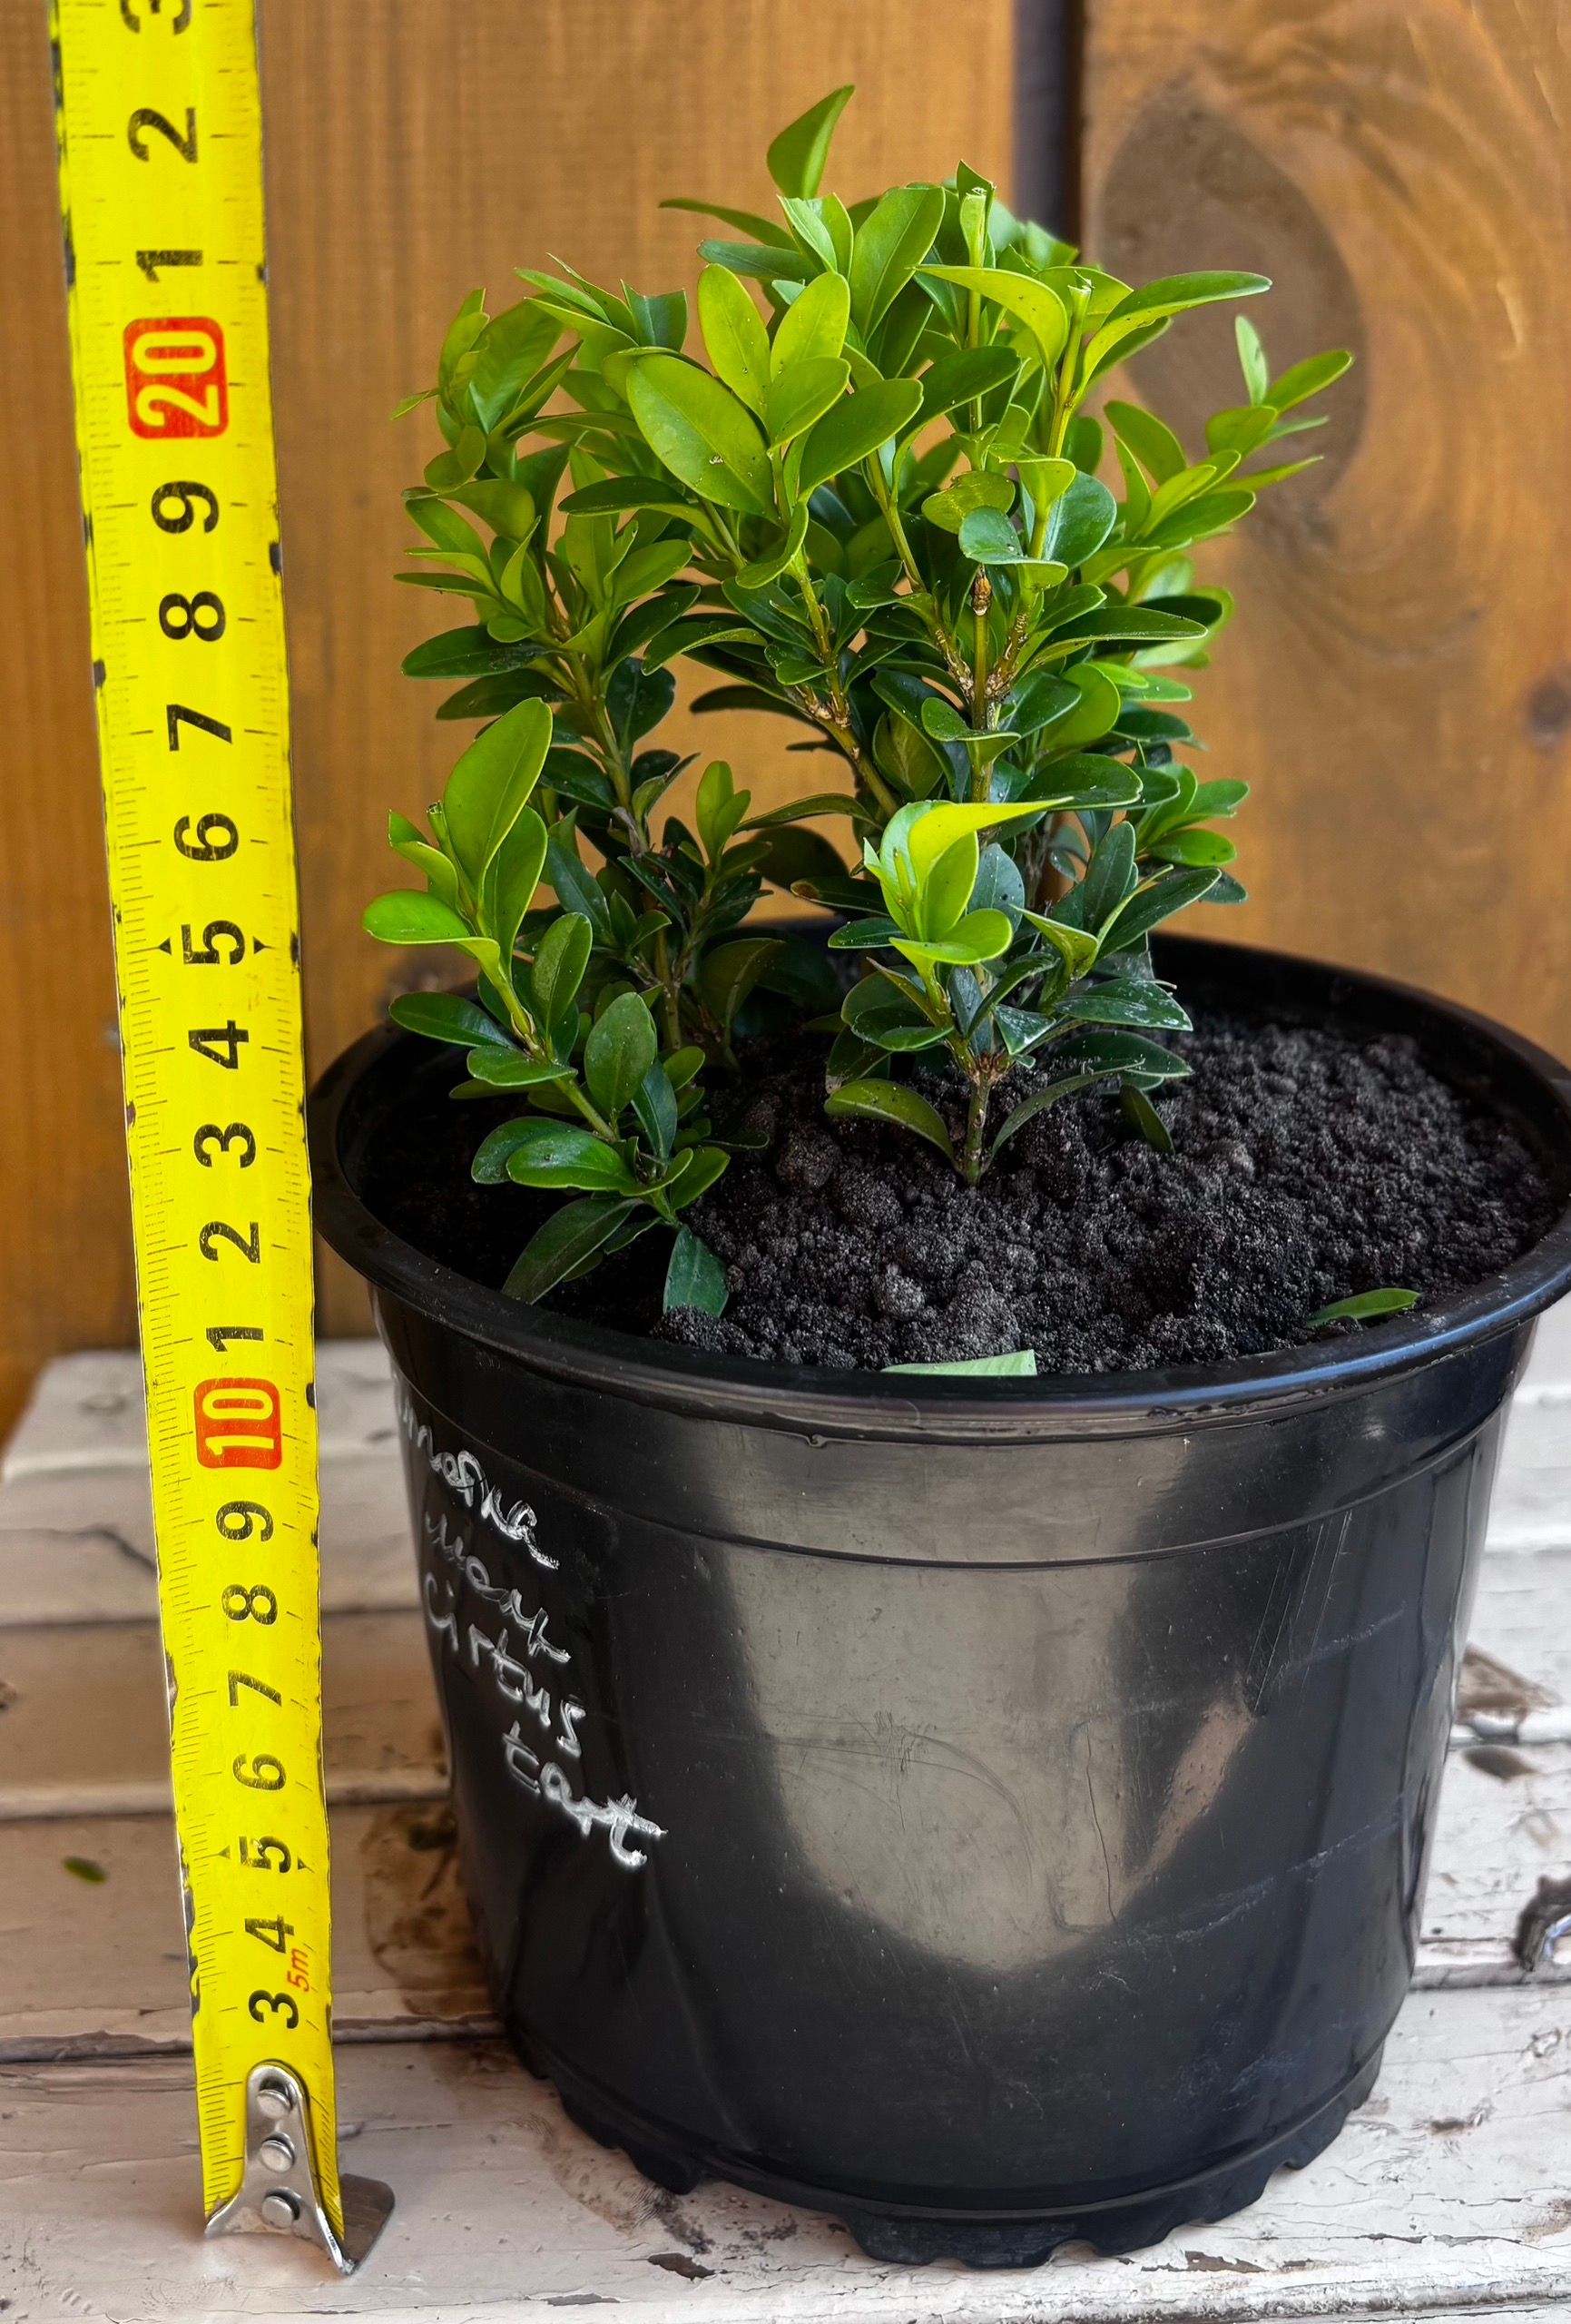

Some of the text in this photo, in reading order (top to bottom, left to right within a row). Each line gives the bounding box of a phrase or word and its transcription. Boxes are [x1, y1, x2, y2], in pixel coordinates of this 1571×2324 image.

[128, 108, 197, 162] 2
[136, 251, 202, 281] 1
[133, 330, 220, 428] 20
[152, 481, 219, 534] 9
[159, 591, 225, 642] 8
[166, 704, 232, 752] 7
[174, 813, 239, 862] 6
[182, 921, 245, 965] 5
[188, 1020, 249, 1069] 4
[194, 1123, 256, 1168] 3
[200, 1222, 260, 1264] 2
[206, 1326, 263, 1352] 1
[202, 1387, 273, 1457] 10
[216, 1501, 273, 1541] 9
[221, 1584, 279, 1626] 8
[228, 1670, 281, 1707] 7
[232, 1753, 287, 1791] 6
[240, 1837, 291, 1873] 5
[245, 1915, 294, 1954] 4
[287, 1947, 309, 1993] 5m
[249, 1990, 299, 2029] 3
